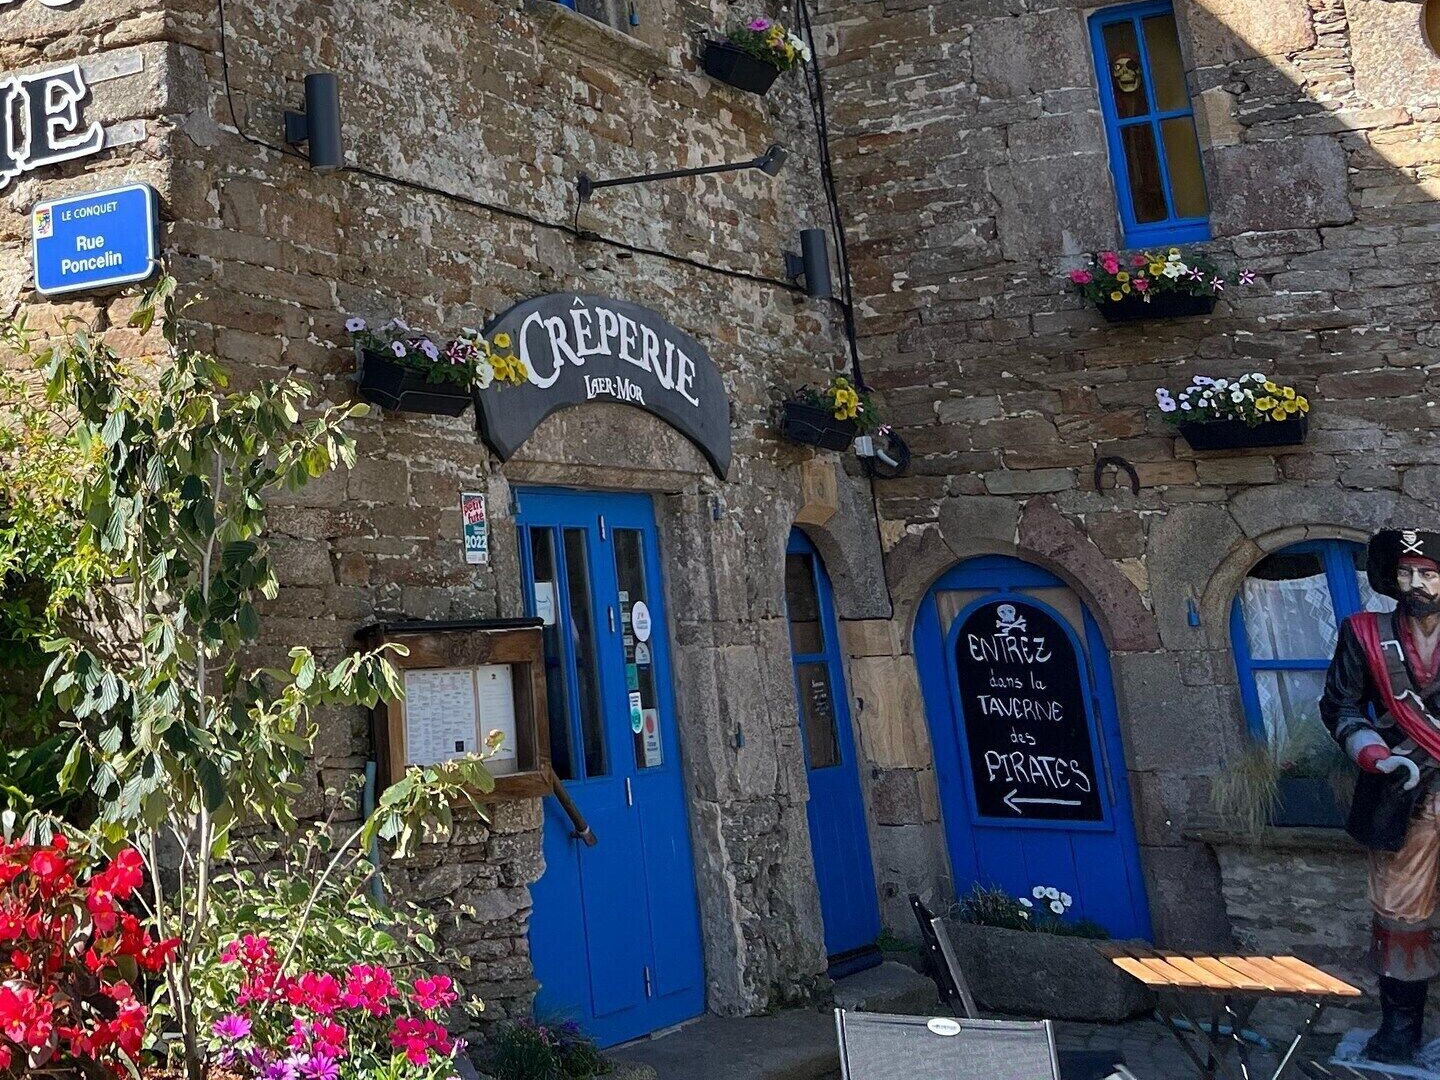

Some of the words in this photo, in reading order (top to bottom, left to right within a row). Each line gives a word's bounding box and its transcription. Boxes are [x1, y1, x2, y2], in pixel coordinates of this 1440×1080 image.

[61, 211, 72, 222] LE
[73, 201, 118, 219] CONQUET
[76, 235, 104, 251] Rue
[61, 250, 122, 275] Poncelin
[519, 296, 699, 407] CRÊPERIE
[465, 535, 487, 549] 2022
[968, 633, 1052, 664] ENTREZ
[989, 668, 1023, 689] dans
[1030, 671, 1047, 690] la
[976, 695, 1063, 722] TAVERNE
[1010, 726, 1036, 745] des
[984, 750, 1091, 792] PIRATES
